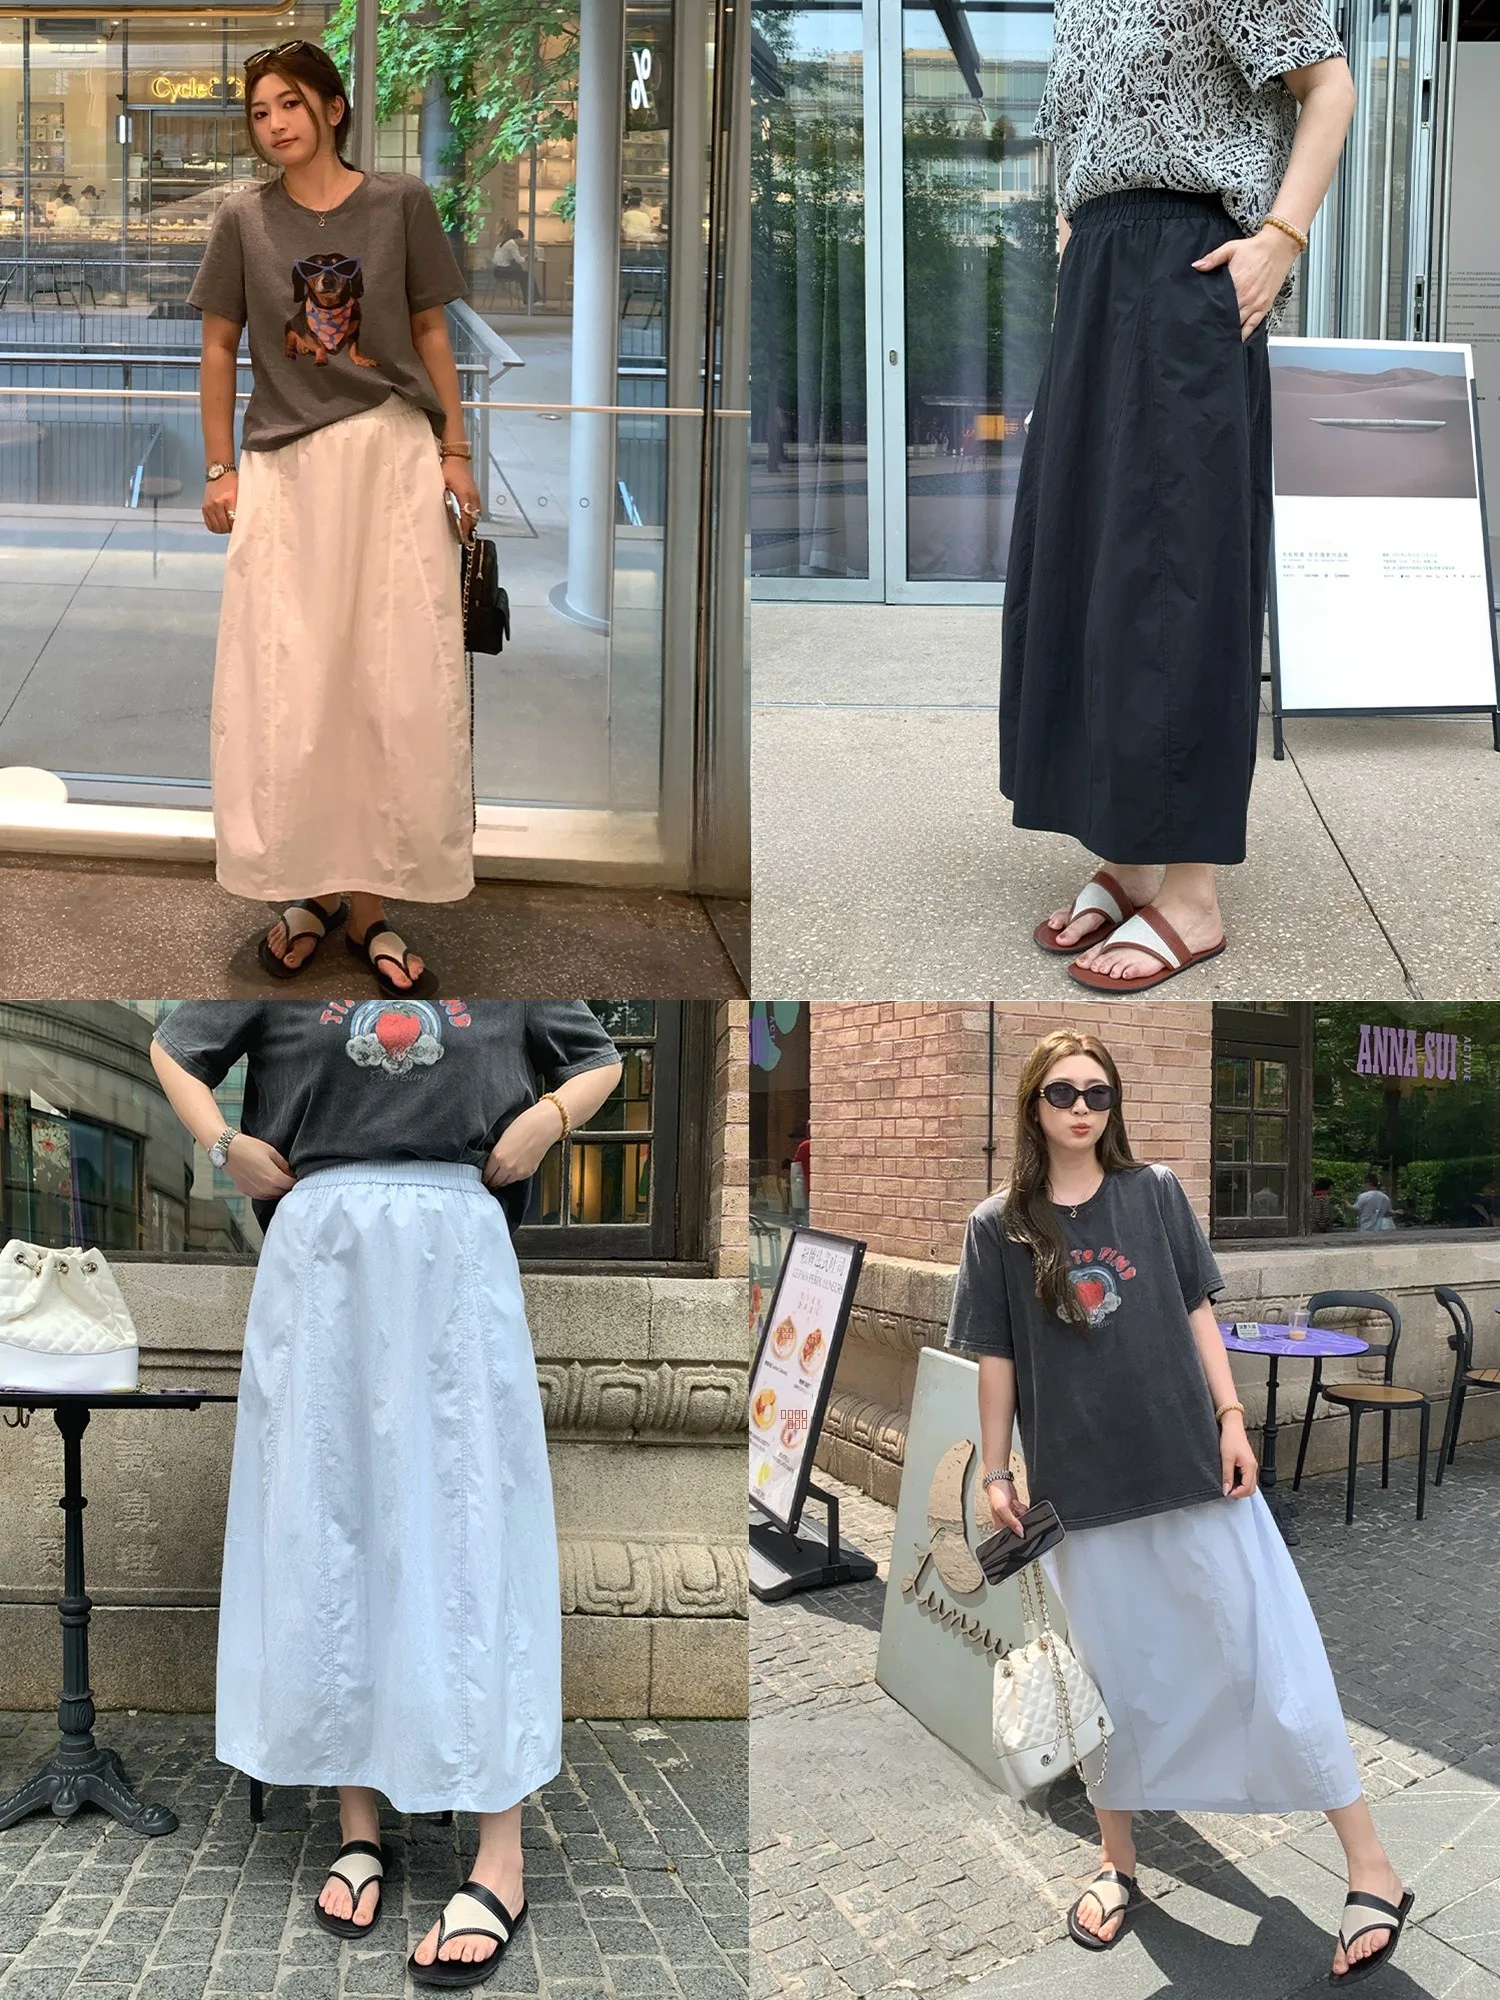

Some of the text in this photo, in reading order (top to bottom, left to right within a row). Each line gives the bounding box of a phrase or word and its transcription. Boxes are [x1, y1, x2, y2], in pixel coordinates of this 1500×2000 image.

[1356, 1024, 1457, 1081] ANNA SUI
[1463, 1036, 1472, 1082] ACTIVE
[1070, 1248, 1094, 1265] TO
